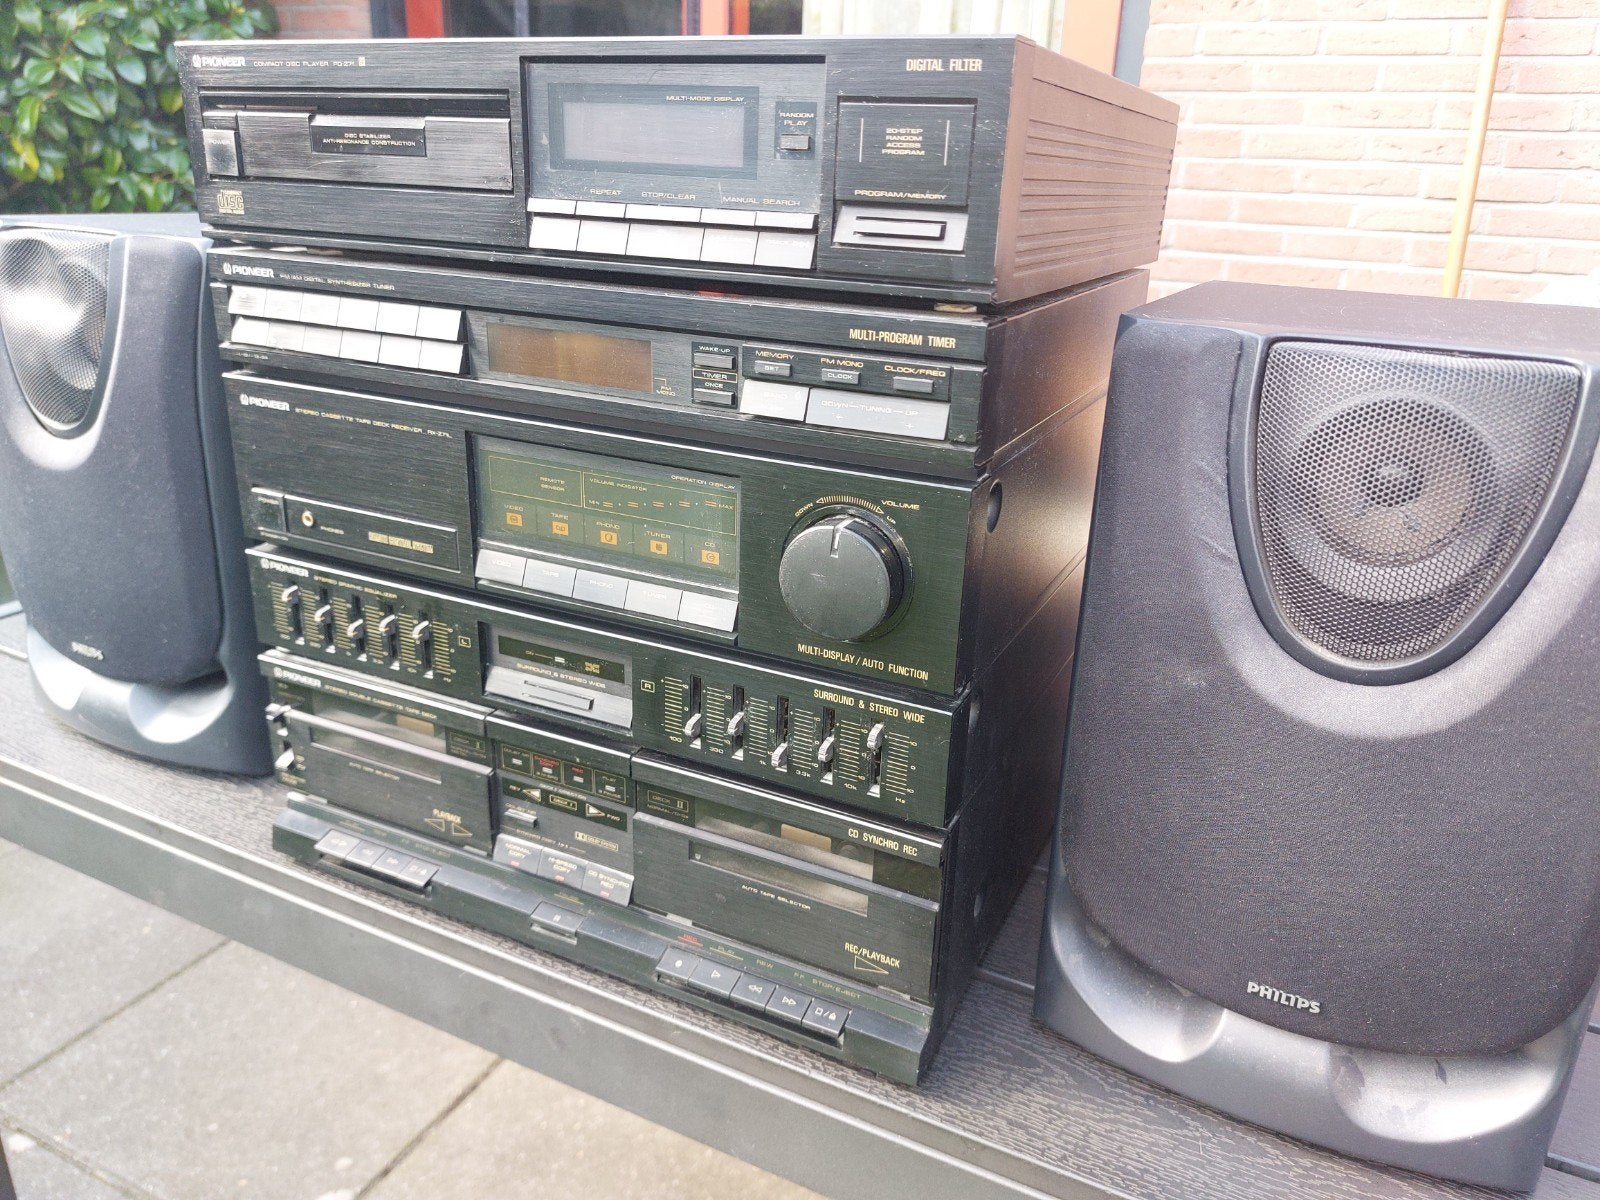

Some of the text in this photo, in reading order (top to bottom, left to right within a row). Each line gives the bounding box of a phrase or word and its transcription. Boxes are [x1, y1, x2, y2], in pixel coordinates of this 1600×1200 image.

[202, 56, 245, 67] PIONEER
[906, 58, 983, 72] DIGITAL FILTER
[641, 191, 696, 200] STOP/CLEAR
[722, 196, 800, 206] MANUAL SEARCH
[855, 189, 946, 200] PROGRAM/MEMORY
[232, 265, 274, 279] PIONEER
[849, 329, 956, 349] MULTI-PROGRAM TIMER
[698, 345, 730, 353] WAKE-UP
[755, 351, 794, 360] MEMORY
[820, 358, 864, 368] FM MONO
[702, 372, 727, 380] TIMER
[884, 365, 946, 376] CLOCK/FREQ
[249, 396, 290, 411] PIONEER
[821, 400, 920, 417] DOWN TUNING UP
[671, 474, 707, 485] OPERATION
[718, 503, 734, 511] MAX
[794, 502, 815, 518] DOWN
[881, 499, 920, 511] VOLUME
[596, 521, 620, 530] PHONO
[646, 530, 671, 539] TUNER
[269, 560, 309, 578] PIONEER
[797, 643, 855, 664] MULTI-DISPLAY
[862, 657, 884, 671] AUTO
[888, 664, 929, 681] FUNCTION
[283, 670, 321, 688] PIONEER
[516, 662, 551, 676] SURROUND
[560, 673, 587, 684] STEREO
[813, 689, 925, 725] SURROUND & STEREO WIDE
[848, 828, 918, 856] CD SYNCHRO REC
[844, 942, 900, 968] REC/PLAYBACK
[1247, 981, 1321, 1014] PHILIPS
